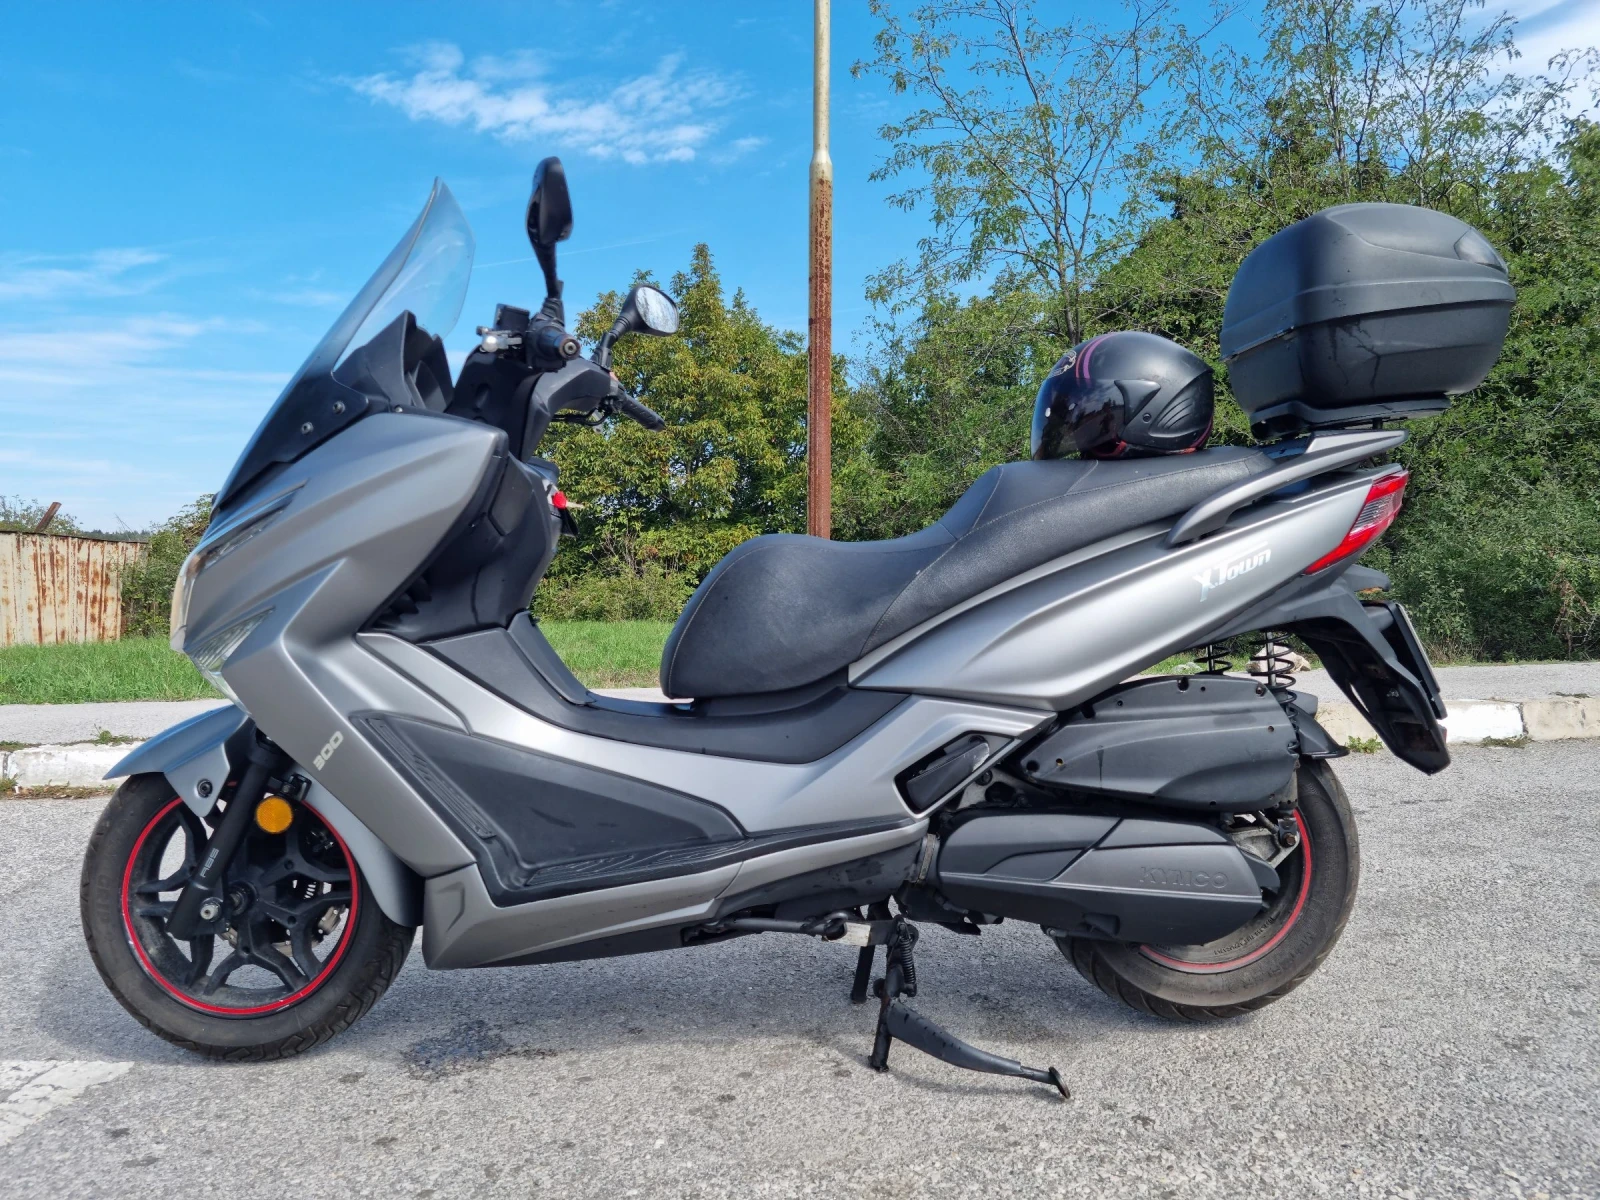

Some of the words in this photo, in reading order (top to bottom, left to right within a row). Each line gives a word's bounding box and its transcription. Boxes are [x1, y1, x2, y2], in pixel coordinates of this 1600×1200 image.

[313, 731, 344, 771] 300
[200, 847, 219, 878] ABS
[1139, 867, 1229, 889] KYMCO
